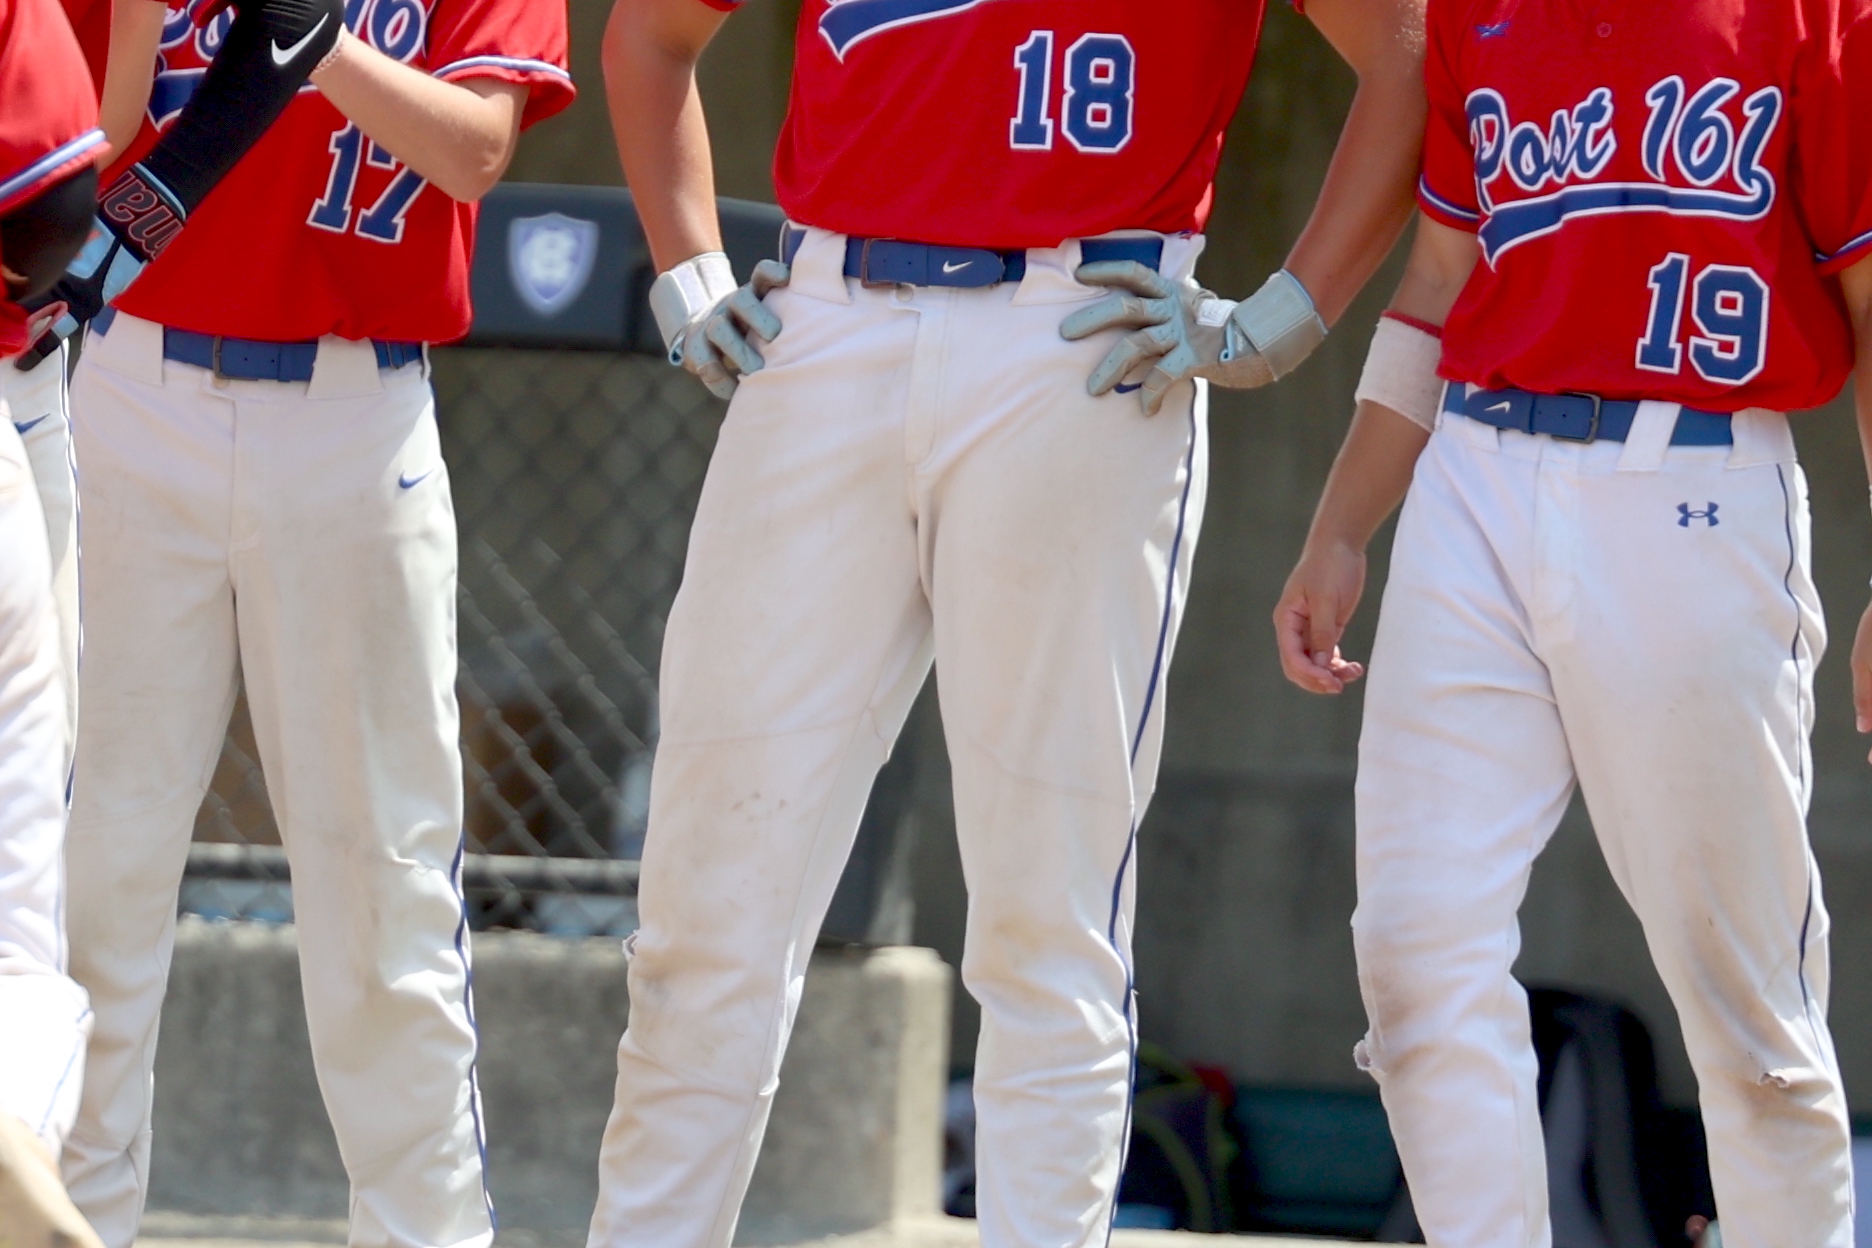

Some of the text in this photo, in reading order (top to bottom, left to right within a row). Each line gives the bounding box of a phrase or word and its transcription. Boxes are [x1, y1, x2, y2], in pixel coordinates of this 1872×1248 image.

[1010, 29, 1135, 153] 18
[1464, 74, 1781, 215] Post 161
[306, 121, 428, 244] 17
[1635, 251, 1770, 385] 19
